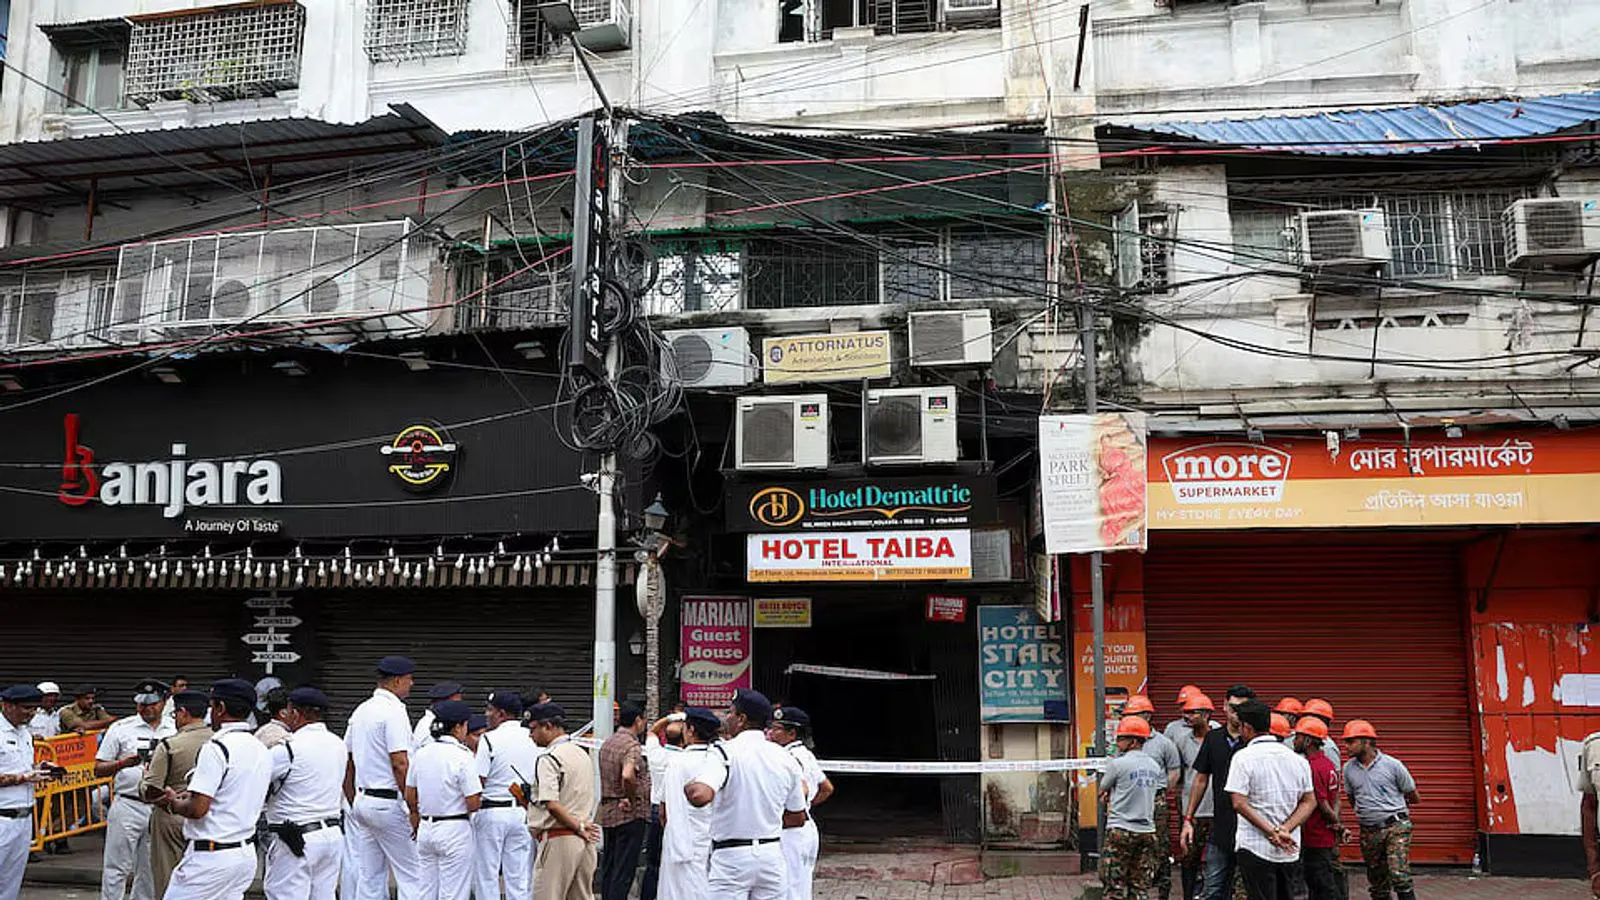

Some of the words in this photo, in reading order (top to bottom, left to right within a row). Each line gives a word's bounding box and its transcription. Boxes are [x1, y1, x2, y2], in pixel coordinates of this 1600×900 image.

[788, 337, 884, 353] ATTORNATUS
[1350, 447, 1397, 471] মোর
[1402, 438, 1535, 475] সুপারমার্কেট
[1050, 459, 1089, 474] PARK
[1174, 453, 1282, 480] more
[1048, 474, 1090, 487] STREET
[809, 486, 862, 509] Hotel
[865, 483, 972, 507] Demattrie
[1179, 486, 1277, 498] SUPERMARKET
[1364, 489, 1425, 510] প্রতিদিন
[1429, 492, 1471, 508] আসা
[1156, 510, 1176, 521] MY
[1178, 509, 1222, 521] STORE
[1228, 508, 1271, 520] EVERY
[1275, 507, 1304, 519] DAY
[185, 520, 193, 532] A
[195, 519, 234, 537] Journey
[237, 519, 250, 532] Of
[252, 519, 280, 532] Taste
[762, 539, 857, 560] HOTEL
[866, 537, 955, 558] TAIBA
[684, 601, 748, 626] MARIAM
[691, 629, 741, 642] Guest
[982, 625, 1062, 641] HOTEL
[688, 645, 743, 659] House
[983, 643, 1063, 665] STAR
[1108, 644, 1135, 653] YOUR
[1082, 655, 1139, 664] FAOURITE
[690, 670, 706, 680] 3rd
[708, 670, 733, 680] Floor
[1083, 665, 1138, 674] PRDUCTS
[984, 669, 1063, 688] CITY
